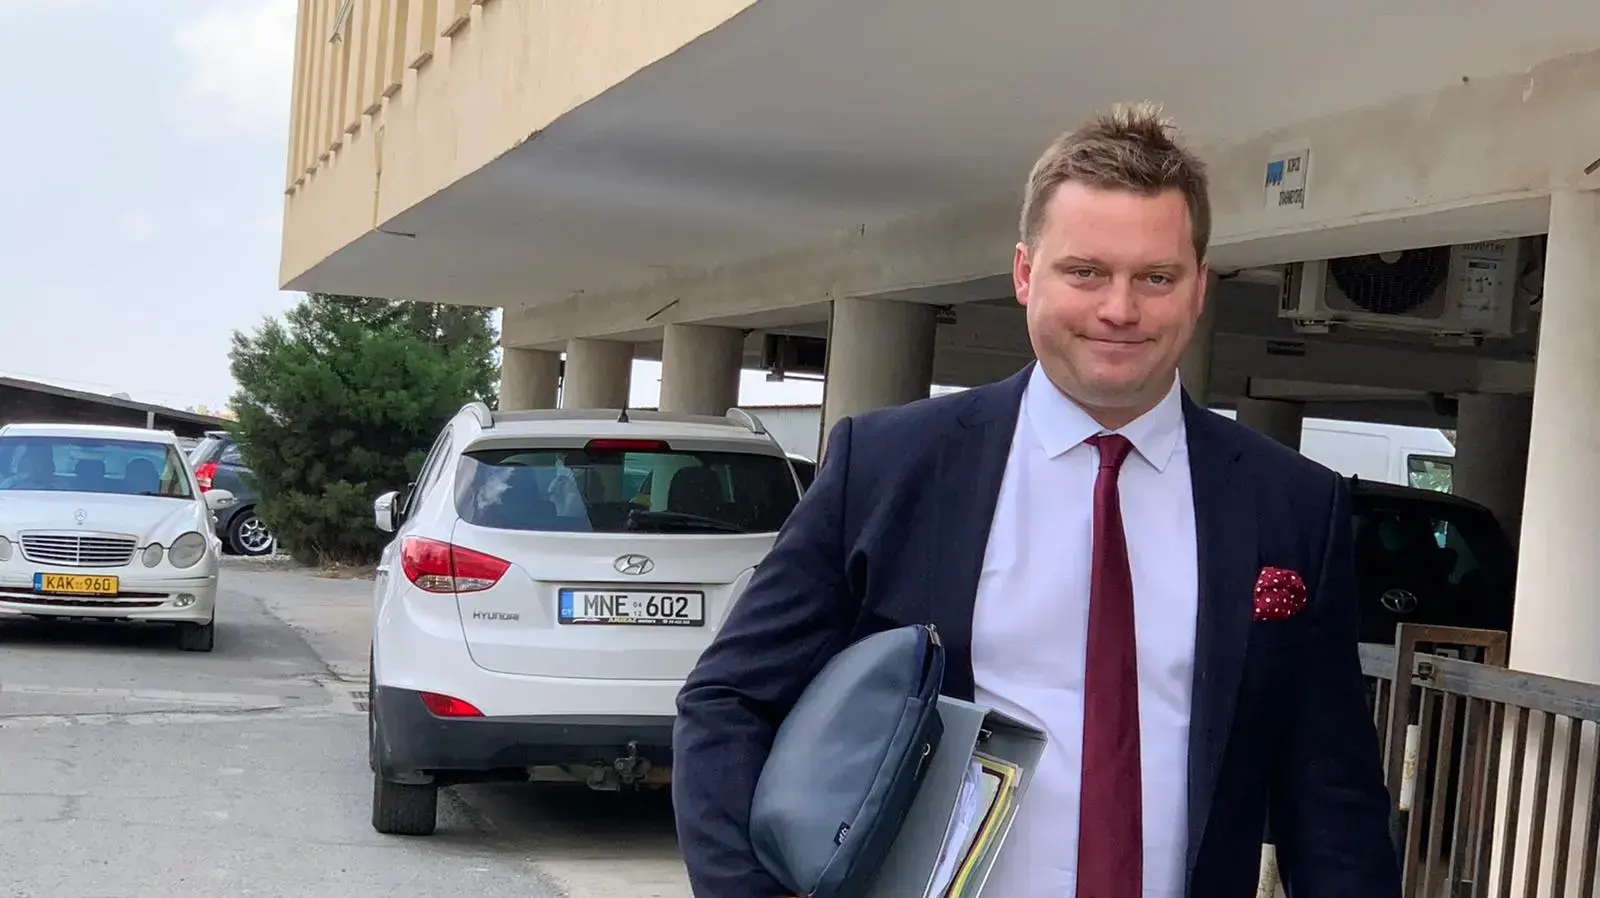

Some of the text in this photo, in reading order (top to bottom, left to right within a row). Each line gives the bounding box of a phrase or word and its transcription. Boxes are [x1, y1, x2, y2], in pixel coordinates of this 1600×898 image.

[46, 575, 75, 590] KAK
[84, 577, 111, 591] 960
[561, 608, 573, 616] CY
[584, 594, 688, 618] MNE 602
[472, 611, 520, 621] HYUNDAI
